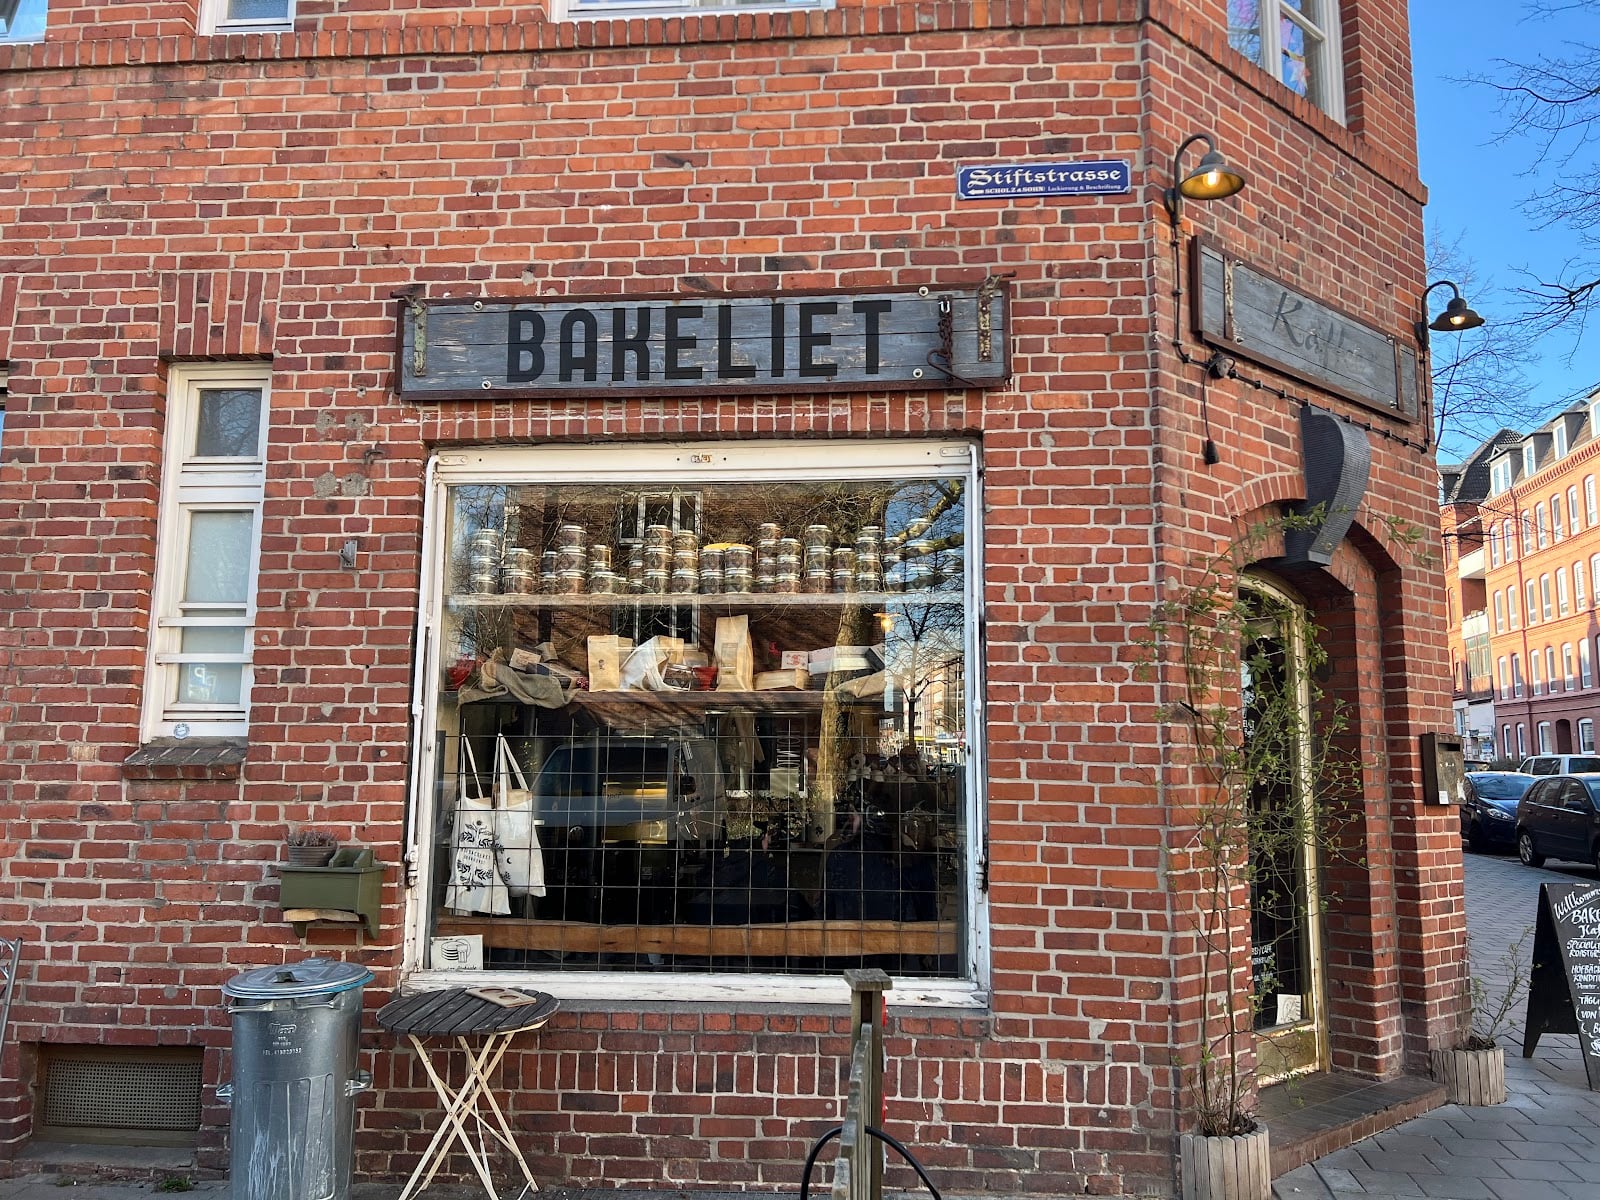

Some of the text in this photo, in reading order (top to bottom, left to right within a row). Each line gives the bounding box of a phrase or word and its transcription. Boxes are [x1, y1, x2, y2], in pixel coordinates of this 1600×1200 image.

[967, 168, 1121, 188] Stiftstrasse
[985, 187, 1016, 195] SCHOLZ
[506, 300, 892, 382] BAKELIET
[1581, 1010, 1597, 1019] VON
